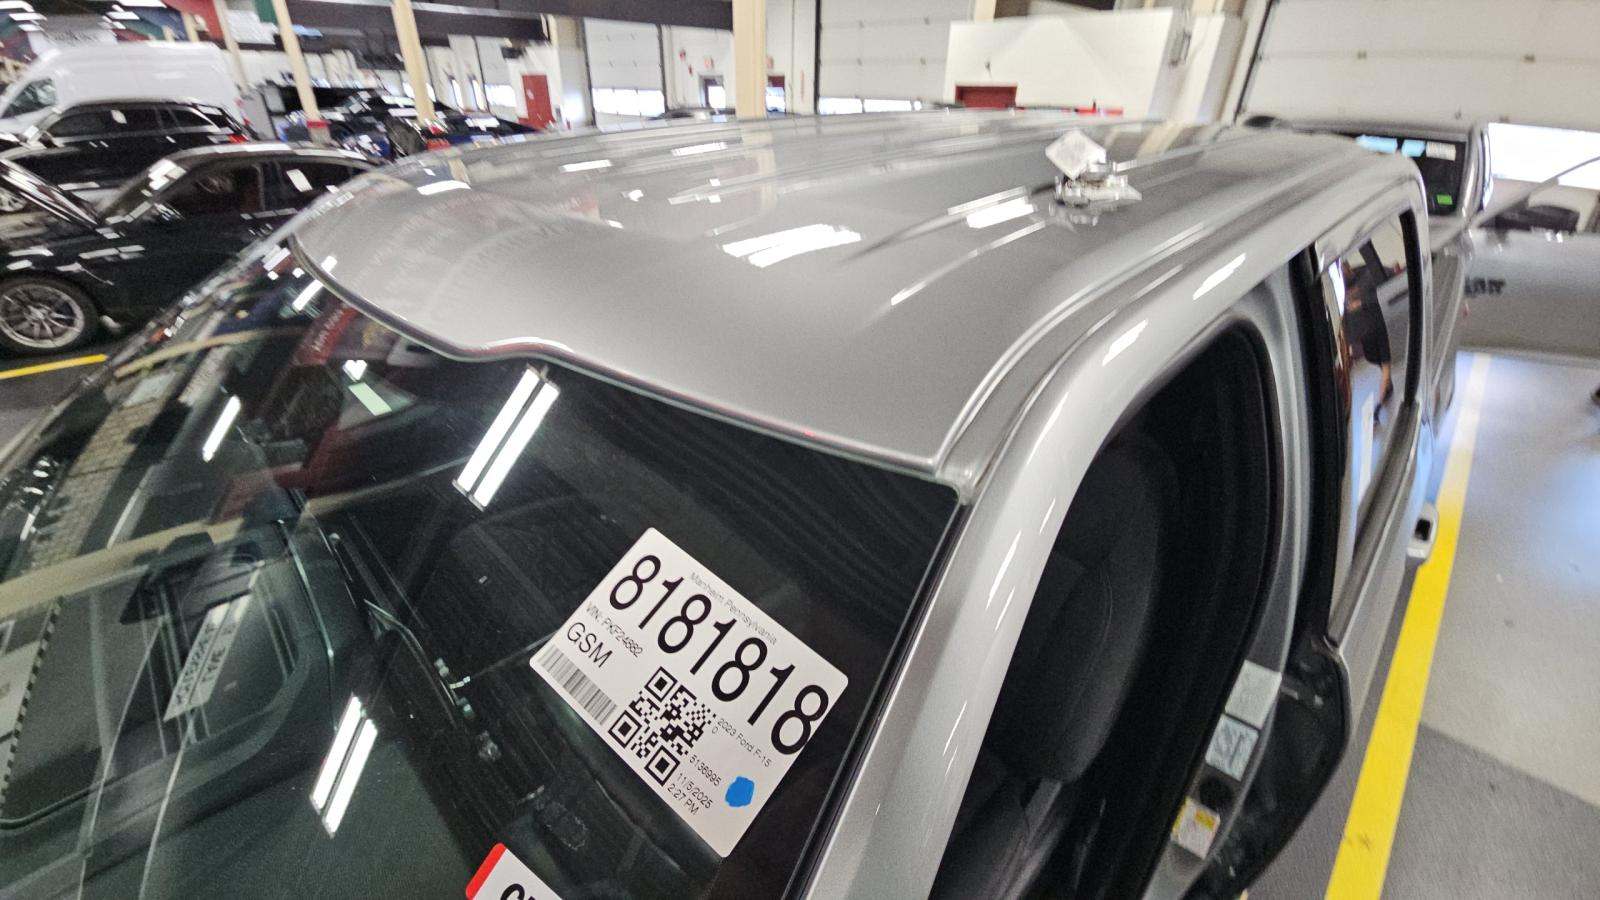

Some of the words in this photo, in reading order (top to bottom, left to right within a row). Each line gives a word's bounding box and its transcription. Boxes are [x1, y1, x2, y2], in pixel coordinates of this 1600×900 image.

[567, 622, 613, 668] GSM
[609, 554, 829, 755] 8181818
[717, 718, 737, 737] 2023
[736, 733, 754, 752] Ford
[753, 748, 772, 768] F-15
[667, 783, 687, 801] 2:27
[684, 798, 699, 815] PM
[677, 772, 713, 809] 11/5/2025
